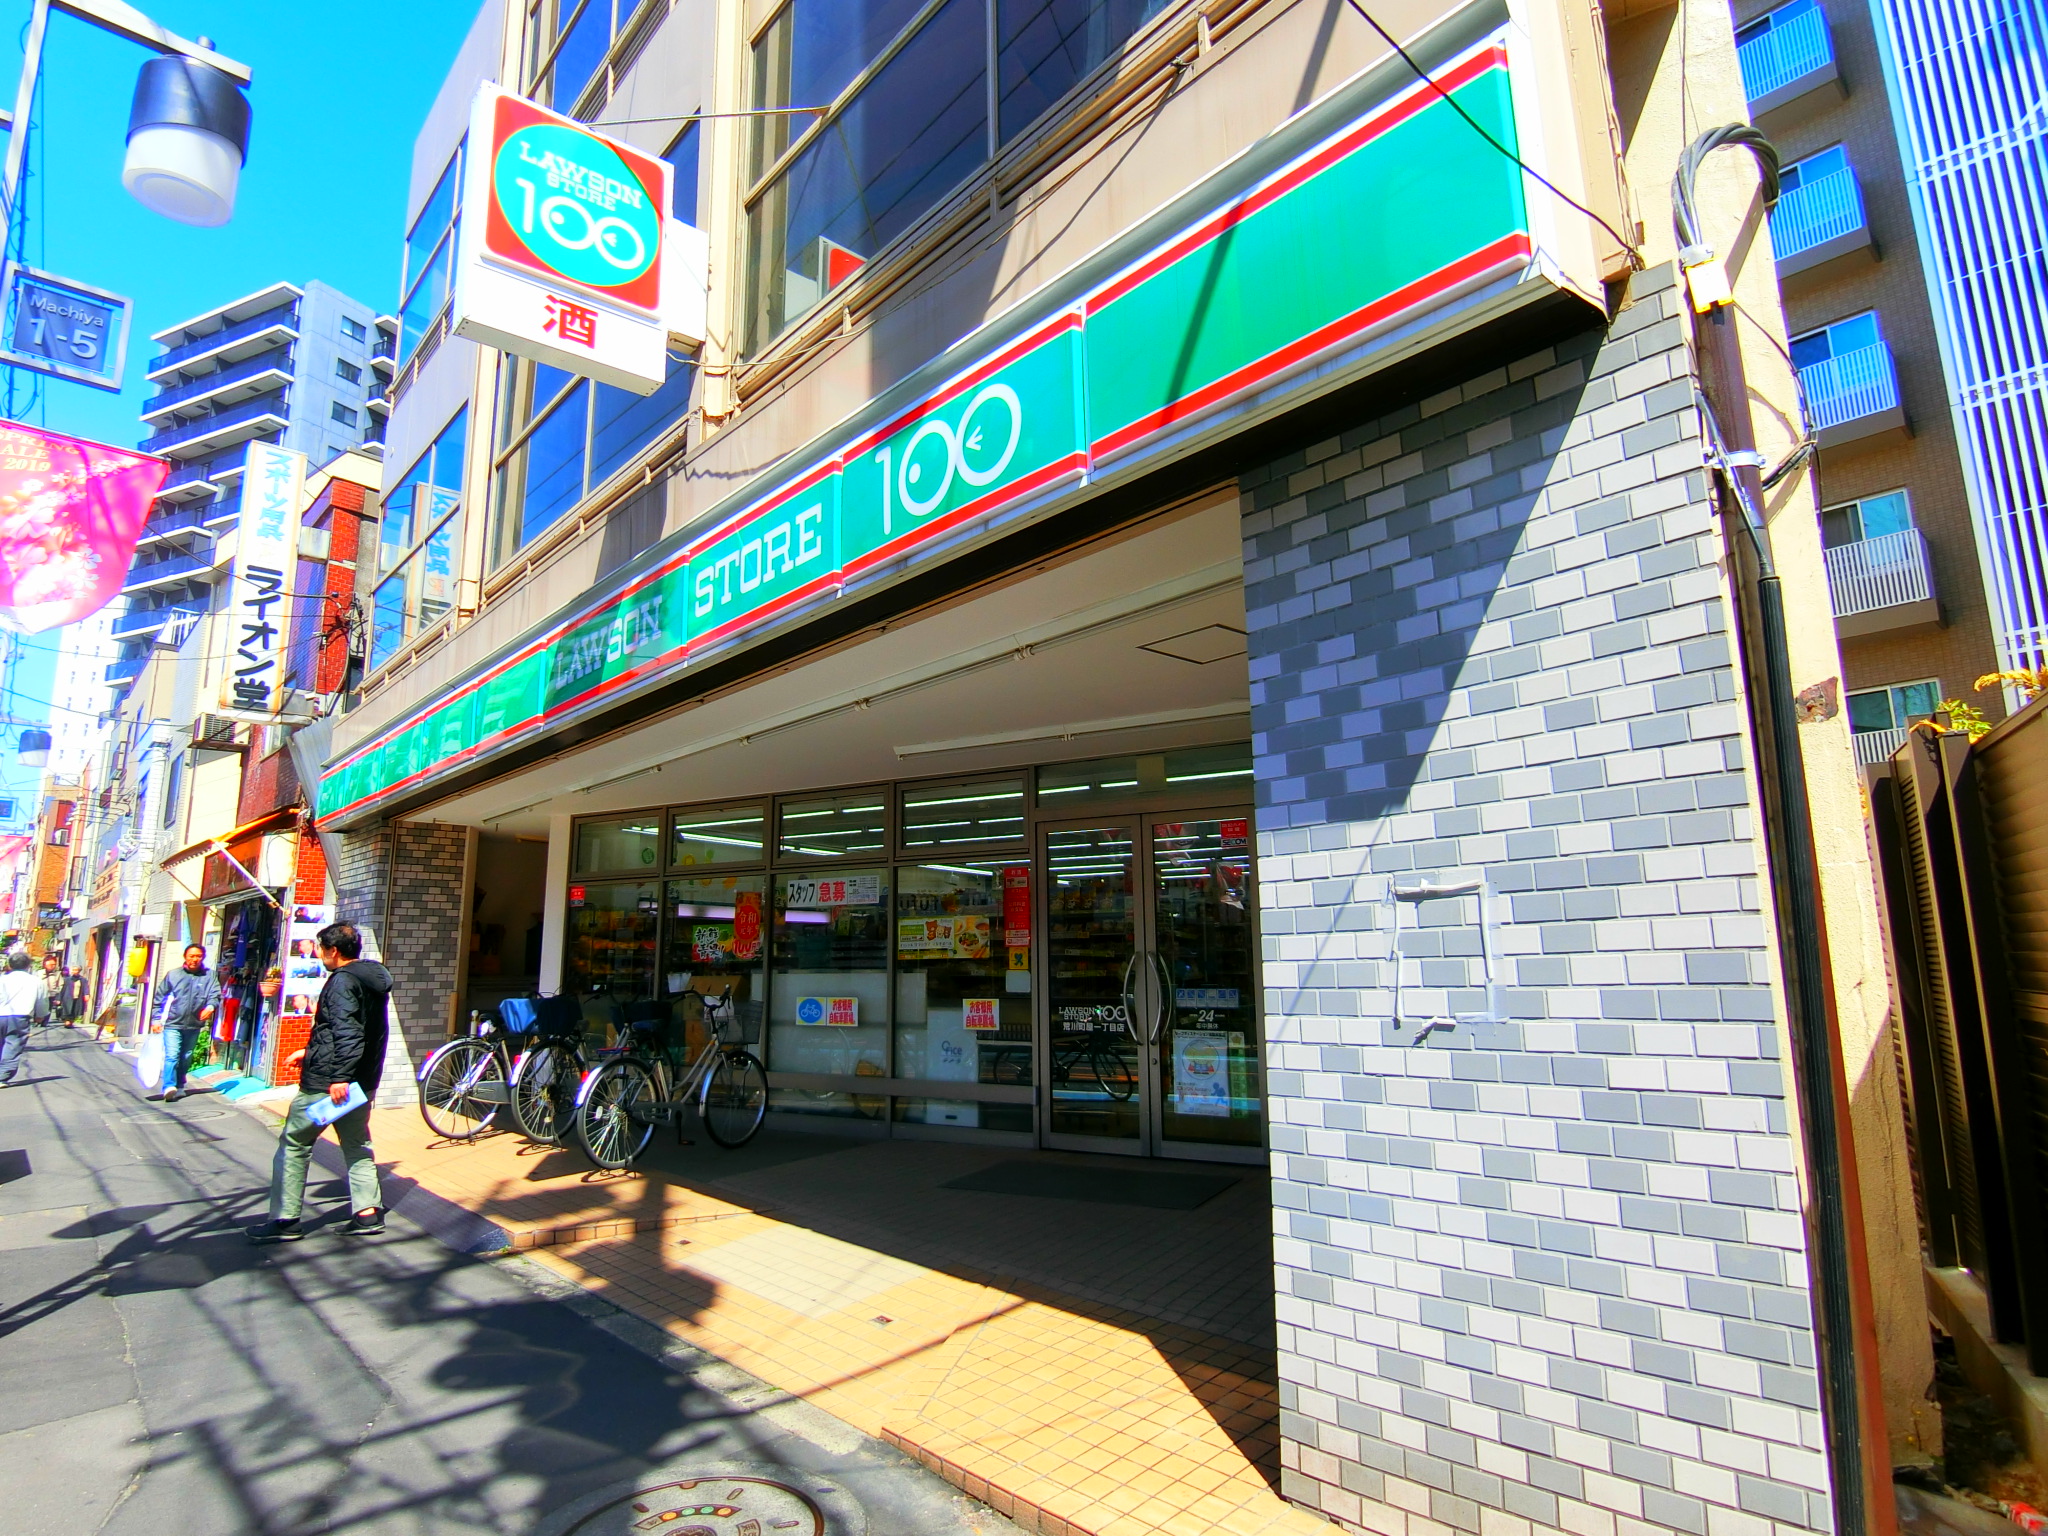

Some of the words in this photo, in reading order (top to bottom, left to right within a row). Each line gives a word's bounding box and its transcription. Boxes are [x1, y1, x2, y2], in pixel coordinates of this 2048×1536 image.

[519, 141, 642, 209] LAWSON
[546, 171, 617, 212] STORE
[515, 177, 646, 271] 100
[30, 294, 104, 328] Machiya
[542, 293, 599, 350] 酒
[29, 317, 99, 361] 1-5
[3, 457, 52, 473] 2019
[555, 595, 664, 690] LAWSON
[694, 502, 824, 619] STORE
[874, 383, 1022, 536] 100
[231, 564, 284, 709] ライオン堂
[818, 880, 847, 903] 急募
[739, 911, 757, 924] 令和
[1197, 1009, 1215, 1022] 24
